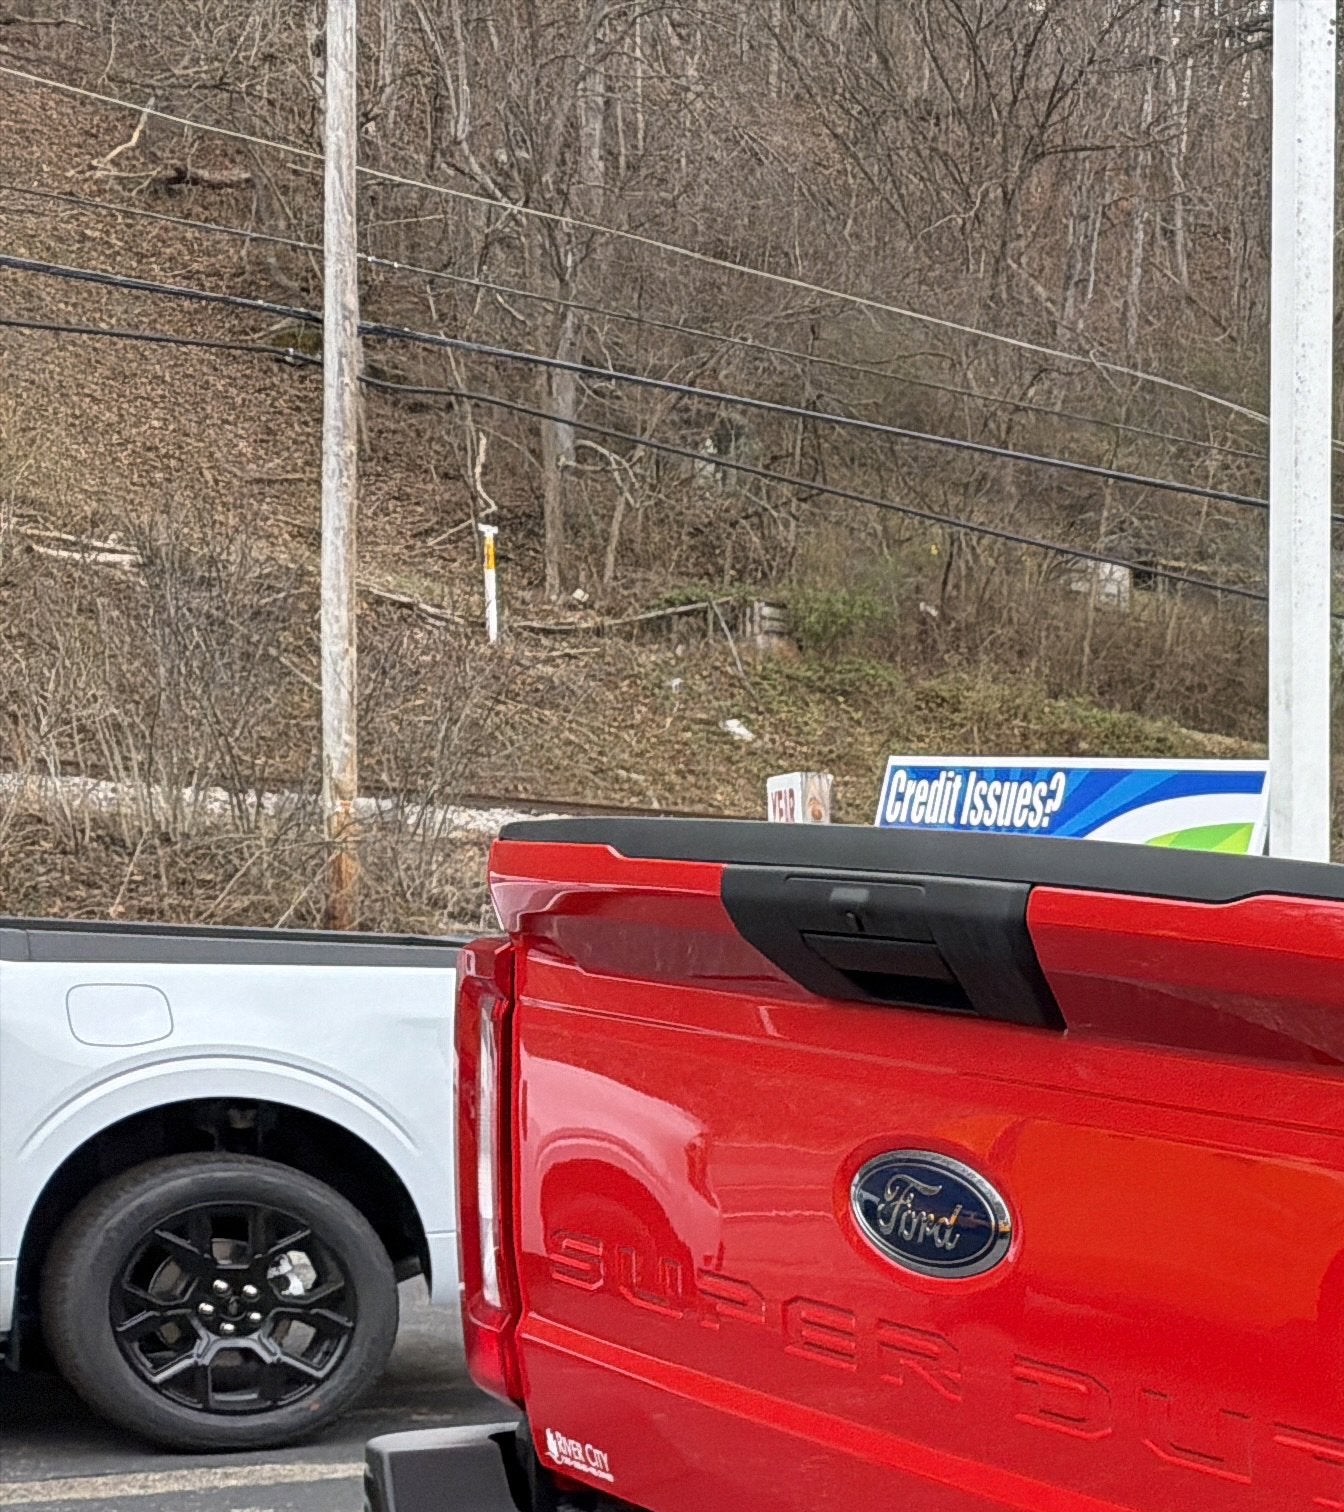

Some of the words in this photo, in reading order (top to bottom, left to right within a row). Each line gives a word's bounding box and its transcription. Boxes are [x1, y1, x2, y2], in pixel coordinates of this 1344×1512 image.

[885, 769, 963, 824] Credit
[959, 770, 1067, 828] Issues?
[872, 1174, 964, 1250] Ford
[549, 1227, 962, 1401] SUPER
[555, 1430, 586, 1463] RIVER
[584, 1443, 610, 1472] CITY
